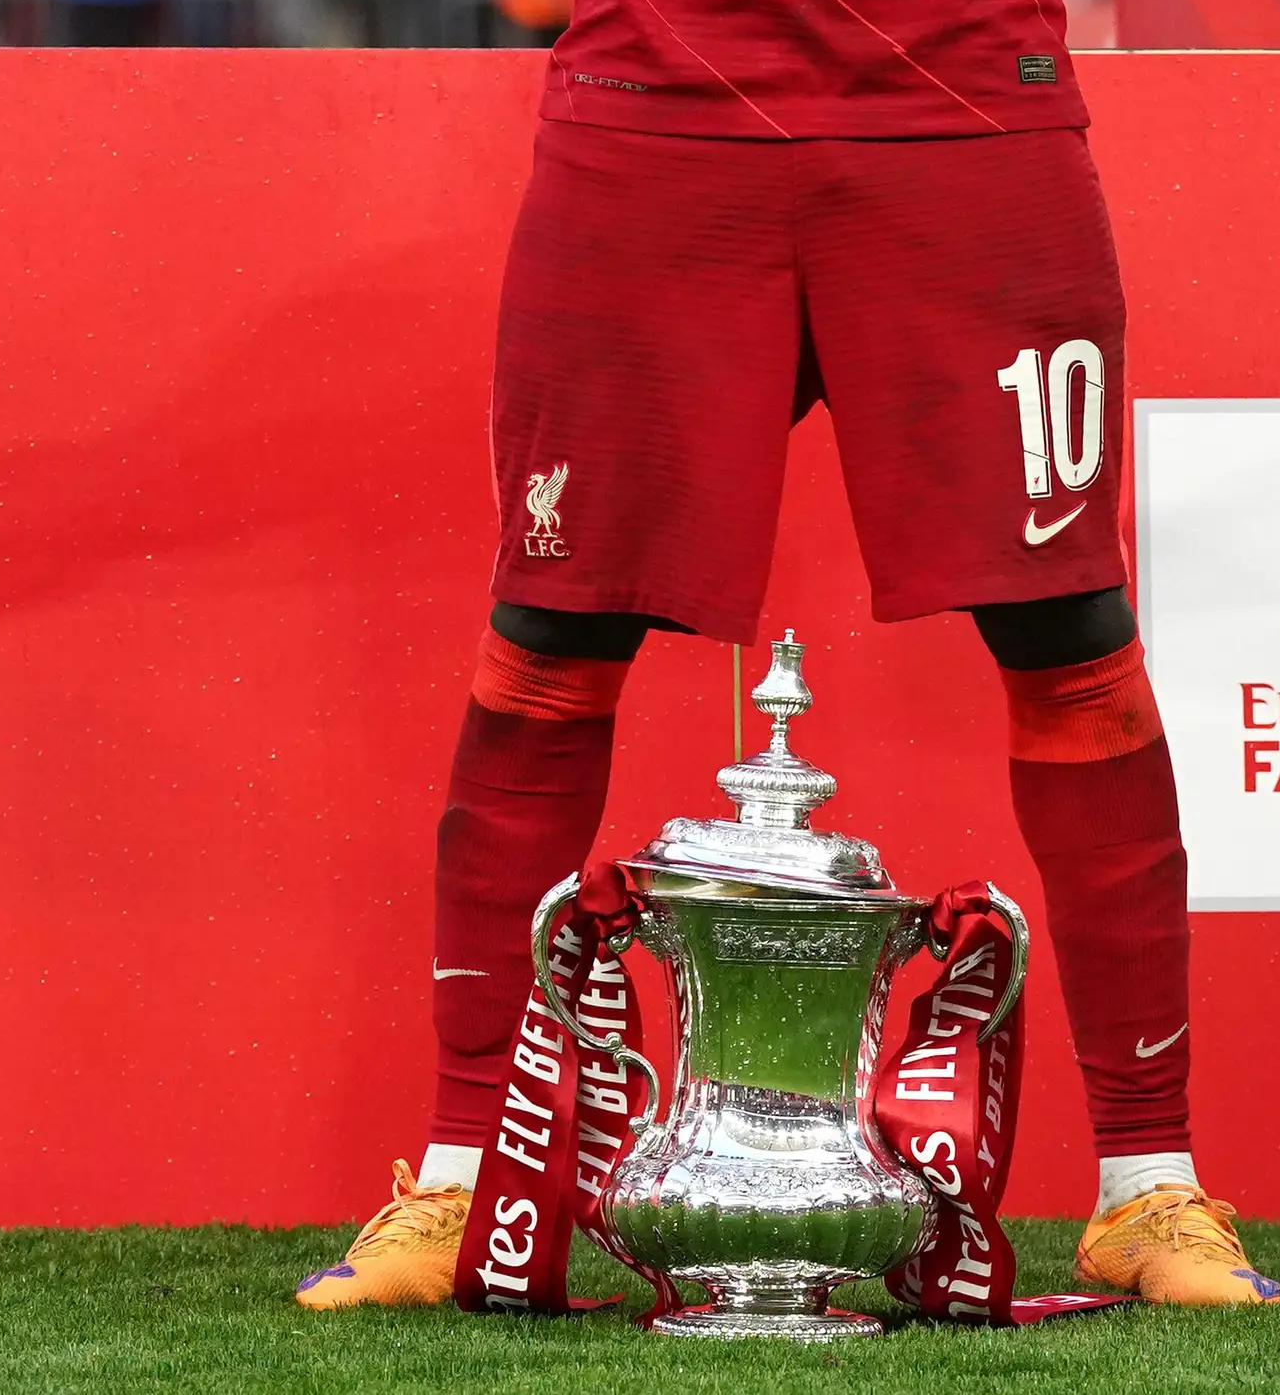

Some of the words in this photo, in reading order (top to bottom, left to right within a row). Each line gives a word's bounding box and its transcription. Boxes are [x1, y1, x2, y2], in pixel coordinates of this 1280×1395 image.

[997, 339, 1105, 498] 10
[497, 1083, 553, 1172] FLY
[577, 1120, 622, 1197] FLY
